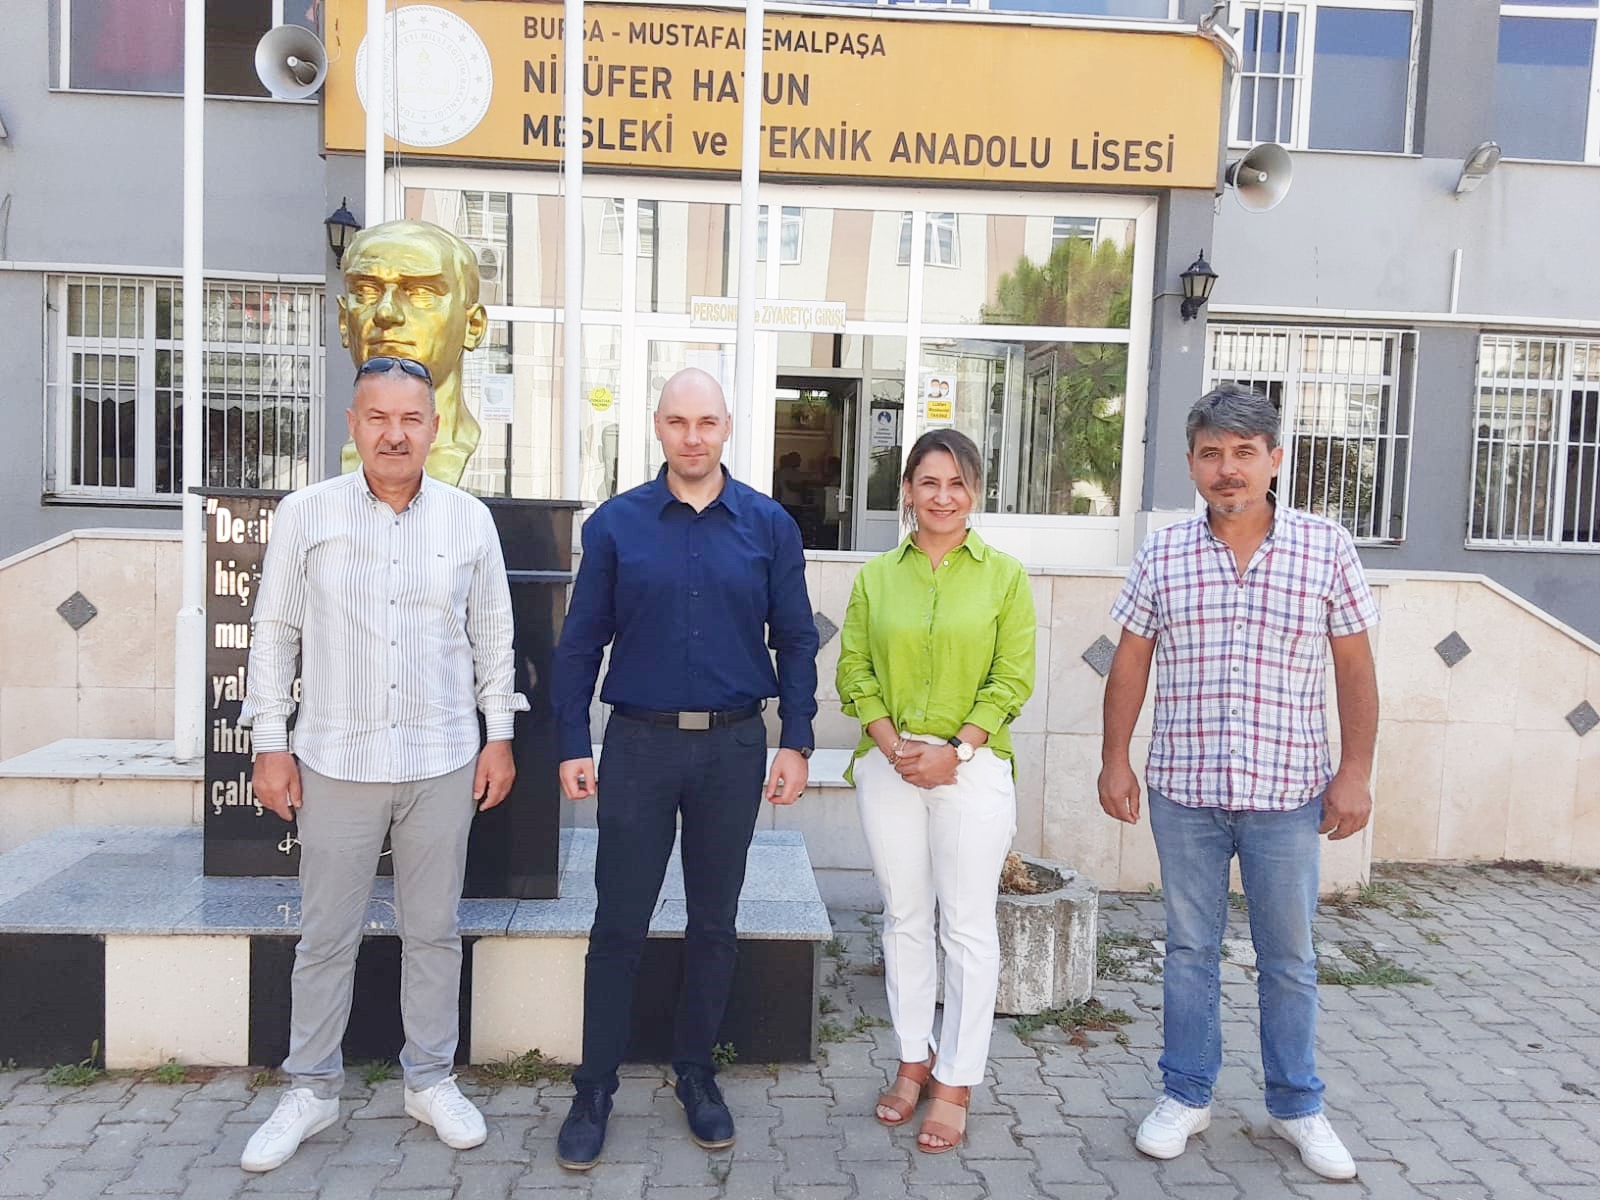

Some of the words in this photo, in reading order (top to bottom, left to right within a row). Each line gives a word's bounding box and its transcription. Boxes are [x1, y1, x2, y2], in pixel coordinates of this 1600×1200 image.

[628, 21, 886, 59] MUSTAFAEMALPAŞA
[523, 53, 672, 99] NİÜFER
[693, 69, 809, 106] HAUN
[522, 112, 673, 153] MESLEKİ
[692, 129, 727, 156] ve
[889, 131, 1051, 169] ANADOLU
[1071, 131, 1175, 173] LİSESİ
[693, 302, 738, 323] PERSON
